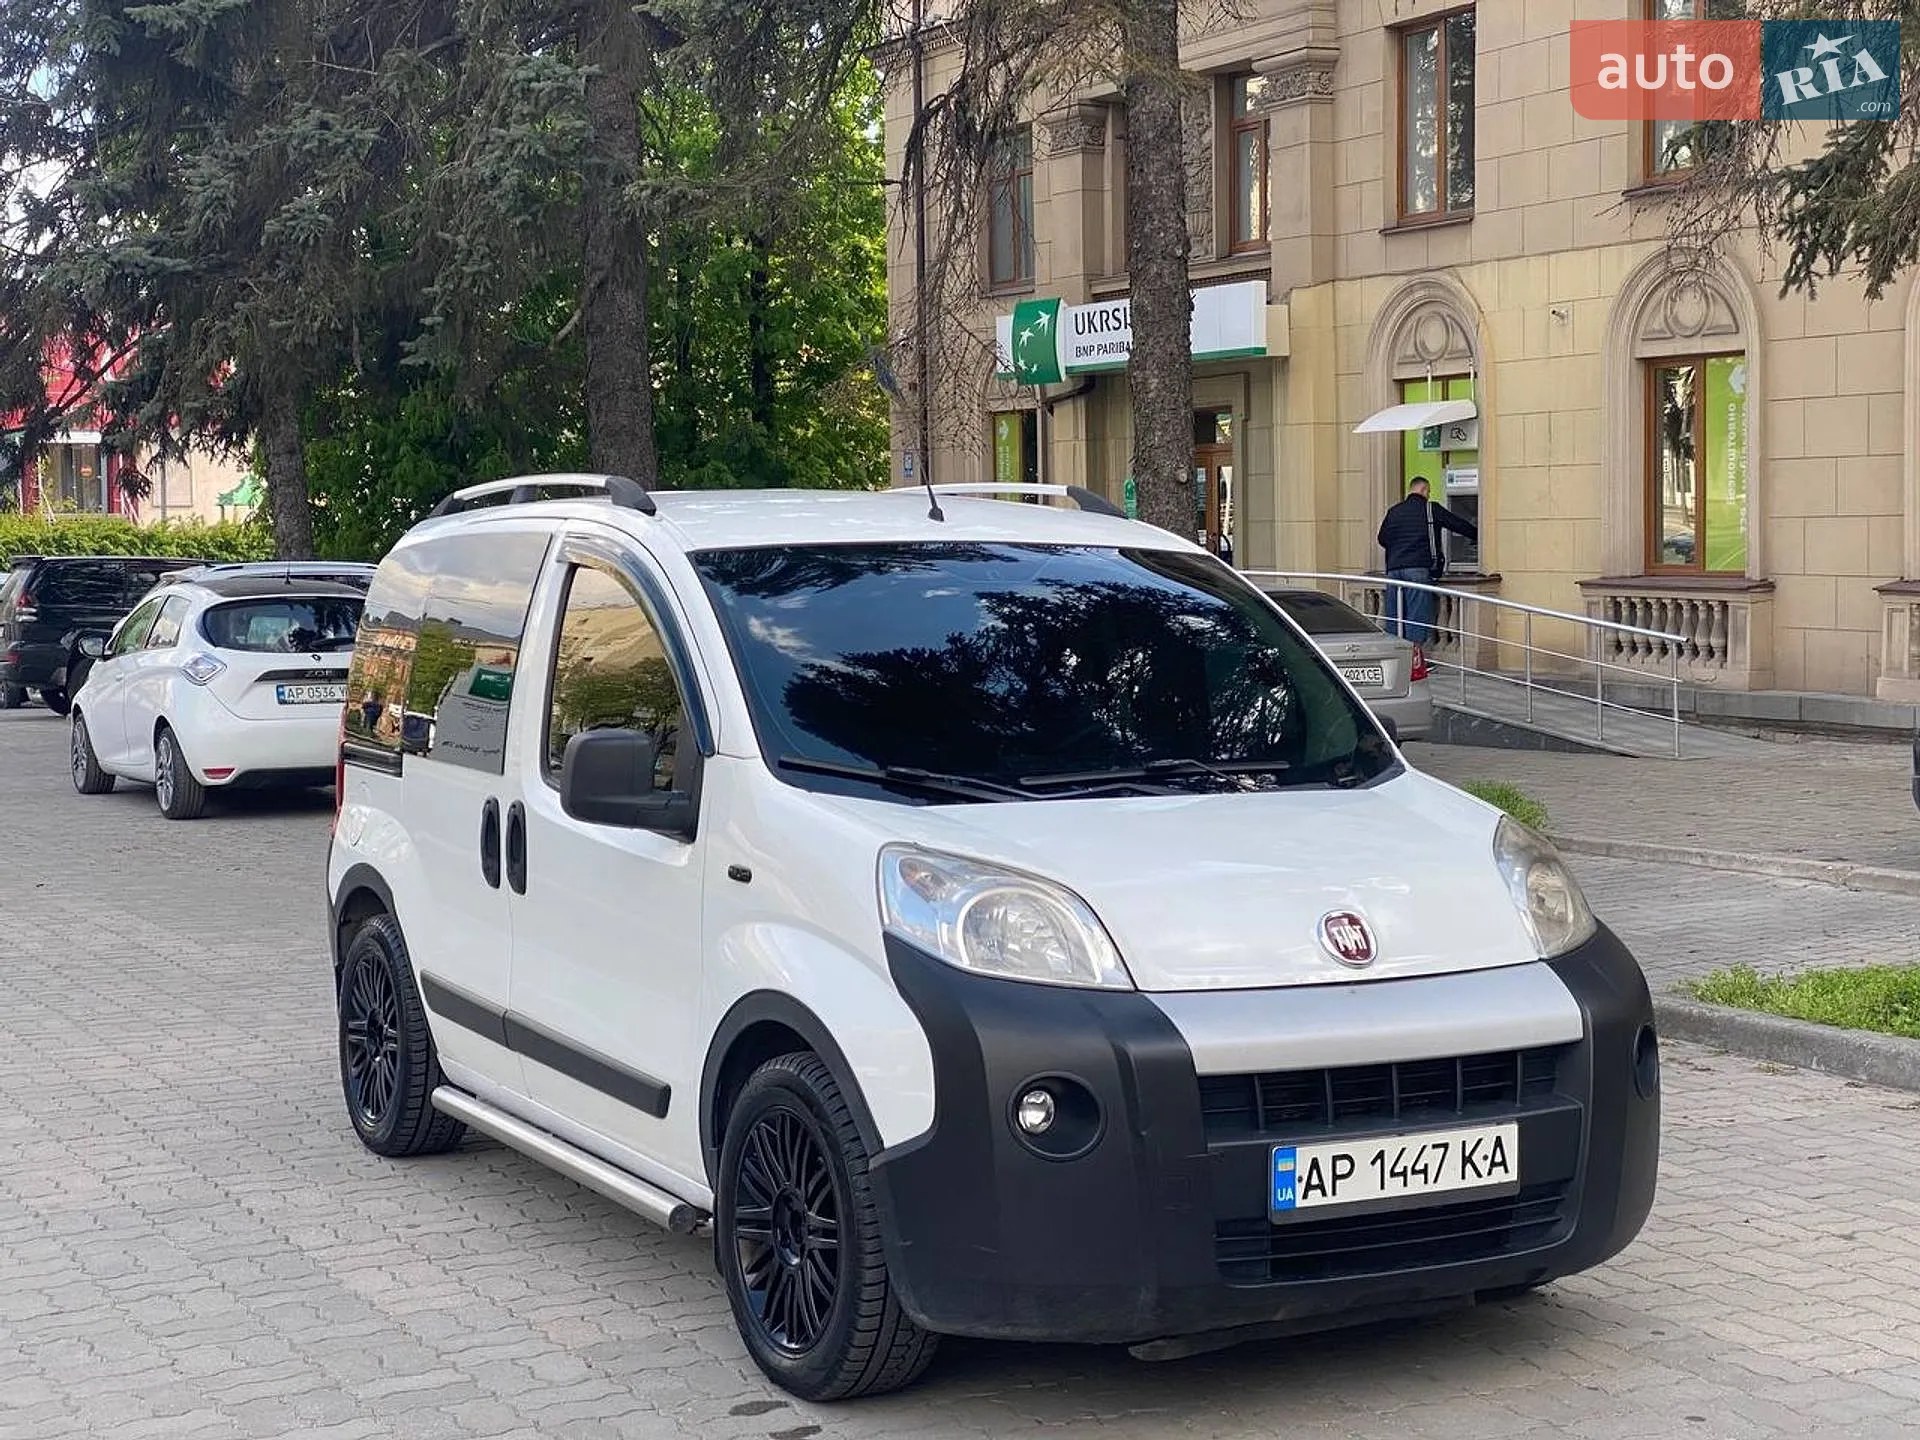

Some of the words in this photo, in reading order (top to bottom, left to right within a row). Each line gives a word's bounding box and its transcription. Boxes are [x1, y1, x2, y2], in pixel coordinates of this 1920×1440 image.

[1074, 307, 1128, 334] UKRSI
[1075, 344, 1095, 358] BNP
[1097, 341, 1131, 355] PARIBA
[287, 687, 304, 698] AP
[307, 687, 336, 698] 0536
[1331, 924, 1367, 951] FIAT
[1302, 1154, 1355, 1200] AP
[1370, 1141, 1450, 1190] 1447
[1461, 1135, 1509, 1180] KA
[1277, 1187, 1294, 1201] UA
